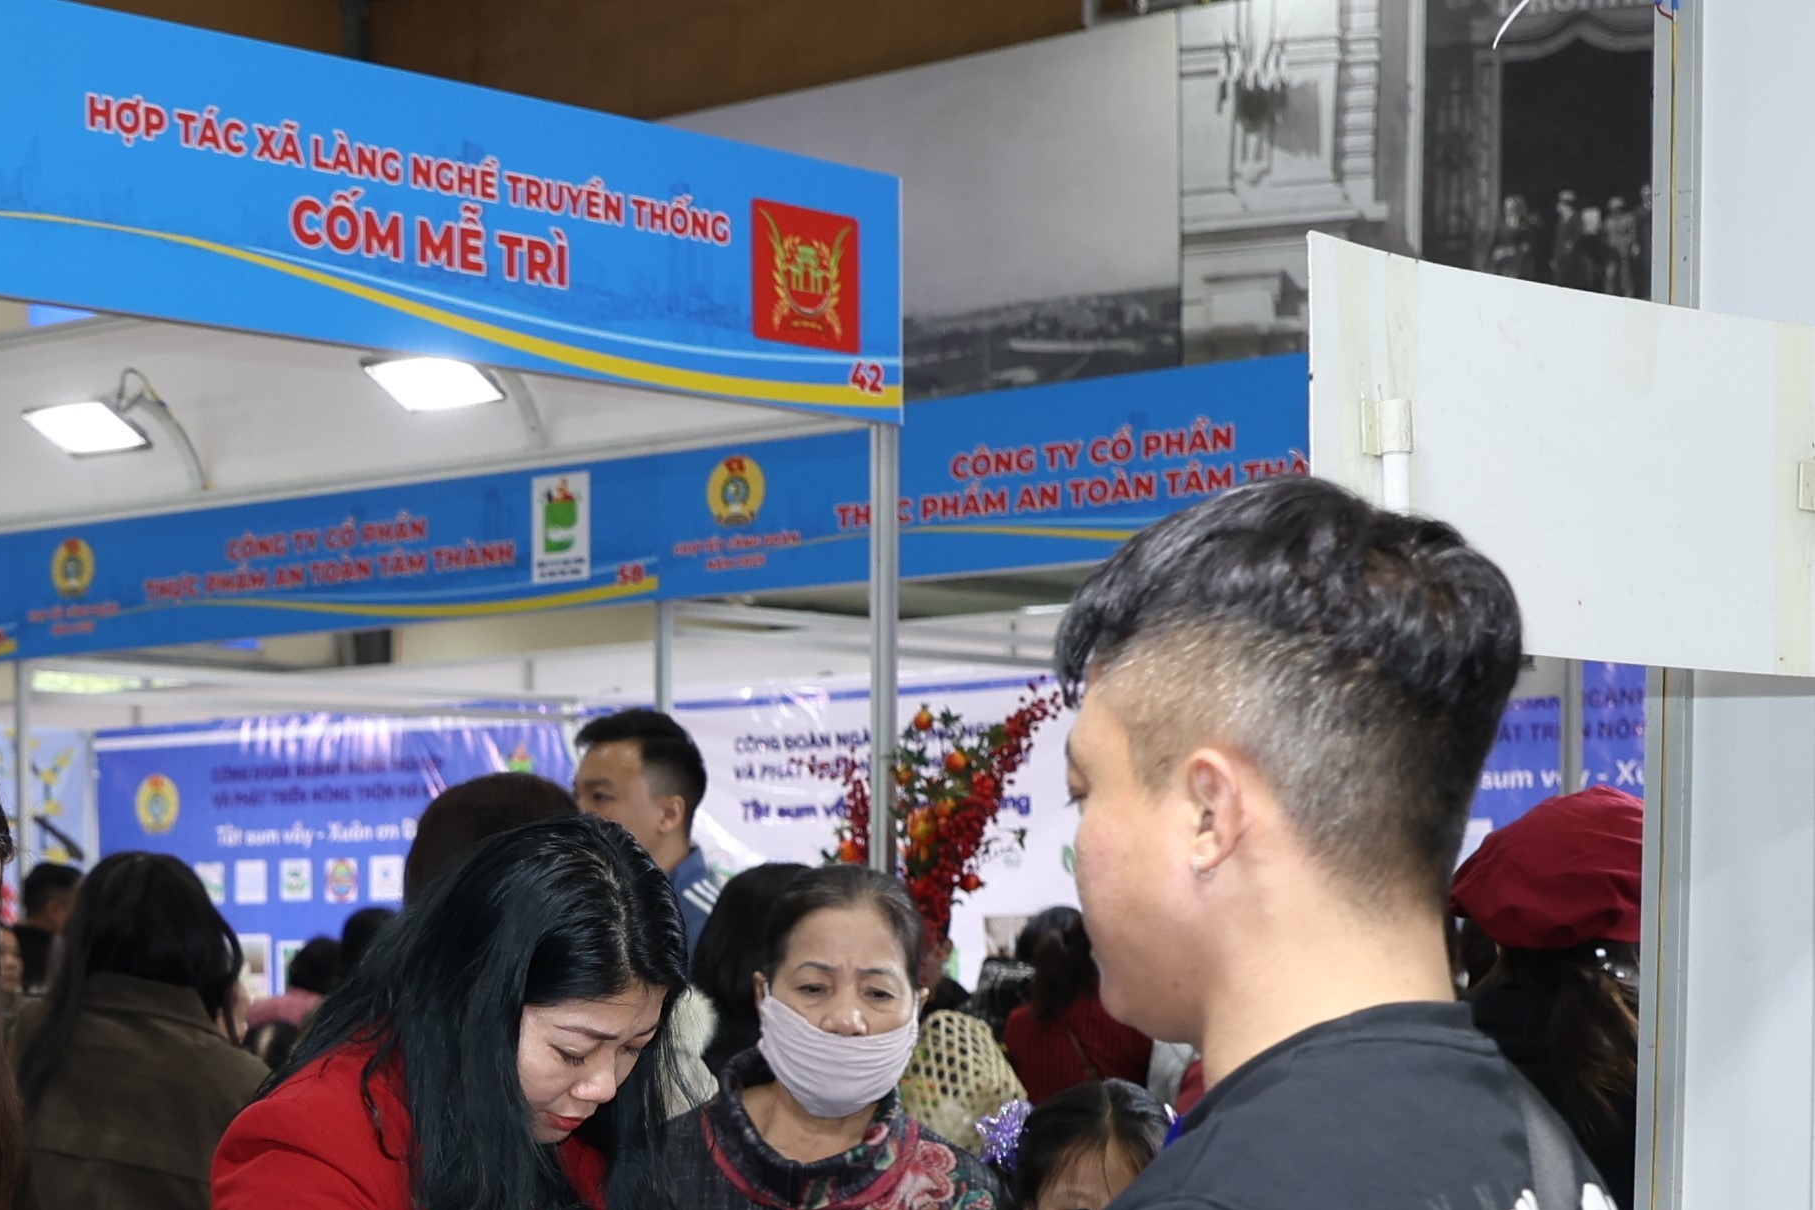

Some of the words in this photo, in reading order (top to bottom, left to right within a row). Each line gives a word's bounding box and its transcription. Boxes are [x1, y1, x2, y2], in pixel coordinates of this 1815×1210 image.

[85, 93, 167, 146] HỢP
[175, 105, 246, 156] TÁC
[253, 121, 306, 166] XÃ
[311, 129, 402, 185] LÀNG
[409, 156, 498, 204] NGHỀ
[504, 174, 625, 225] TRUYỀN
[628, 194, 731, 247] THỐNG
[289, 190, 403, 264] CỐM
[415, 204, 488, 277] MỄ
[496, 223, 570, 292] TRÌ
[848, 360, 887, 398] 42
[951, 443, 1036, 482] CÔNG
[1044, 440, 1083, 472] TY
[1090, 424, 1135, 466] CỔ
[1143, 415, 1236, 460] PHẦN
[835, 503, 914, 531] THC
[921, 480, 1010, 521] PHẨM
[1019, 482, 1060, 512] AN
[1068, 465, 1159, 508] TOÀN
[1165, 460, 1233, 499] TÂM
[226, 532, 287, 561] CÔNG
[293, 530, 320, 554] TY
[325, 517, 356, 552] CỔ
[361, 512, 429, 544] PHẦN
[272, 567, 304, 587] AN
[312, 553, 372, 585] TOÀN
[378, 548, 427, 577] TÂM
[434, 538, 515, 571] THÀNH
[616, 563, 645, 586] 58
[1481, 769, 1534, 790] sum
